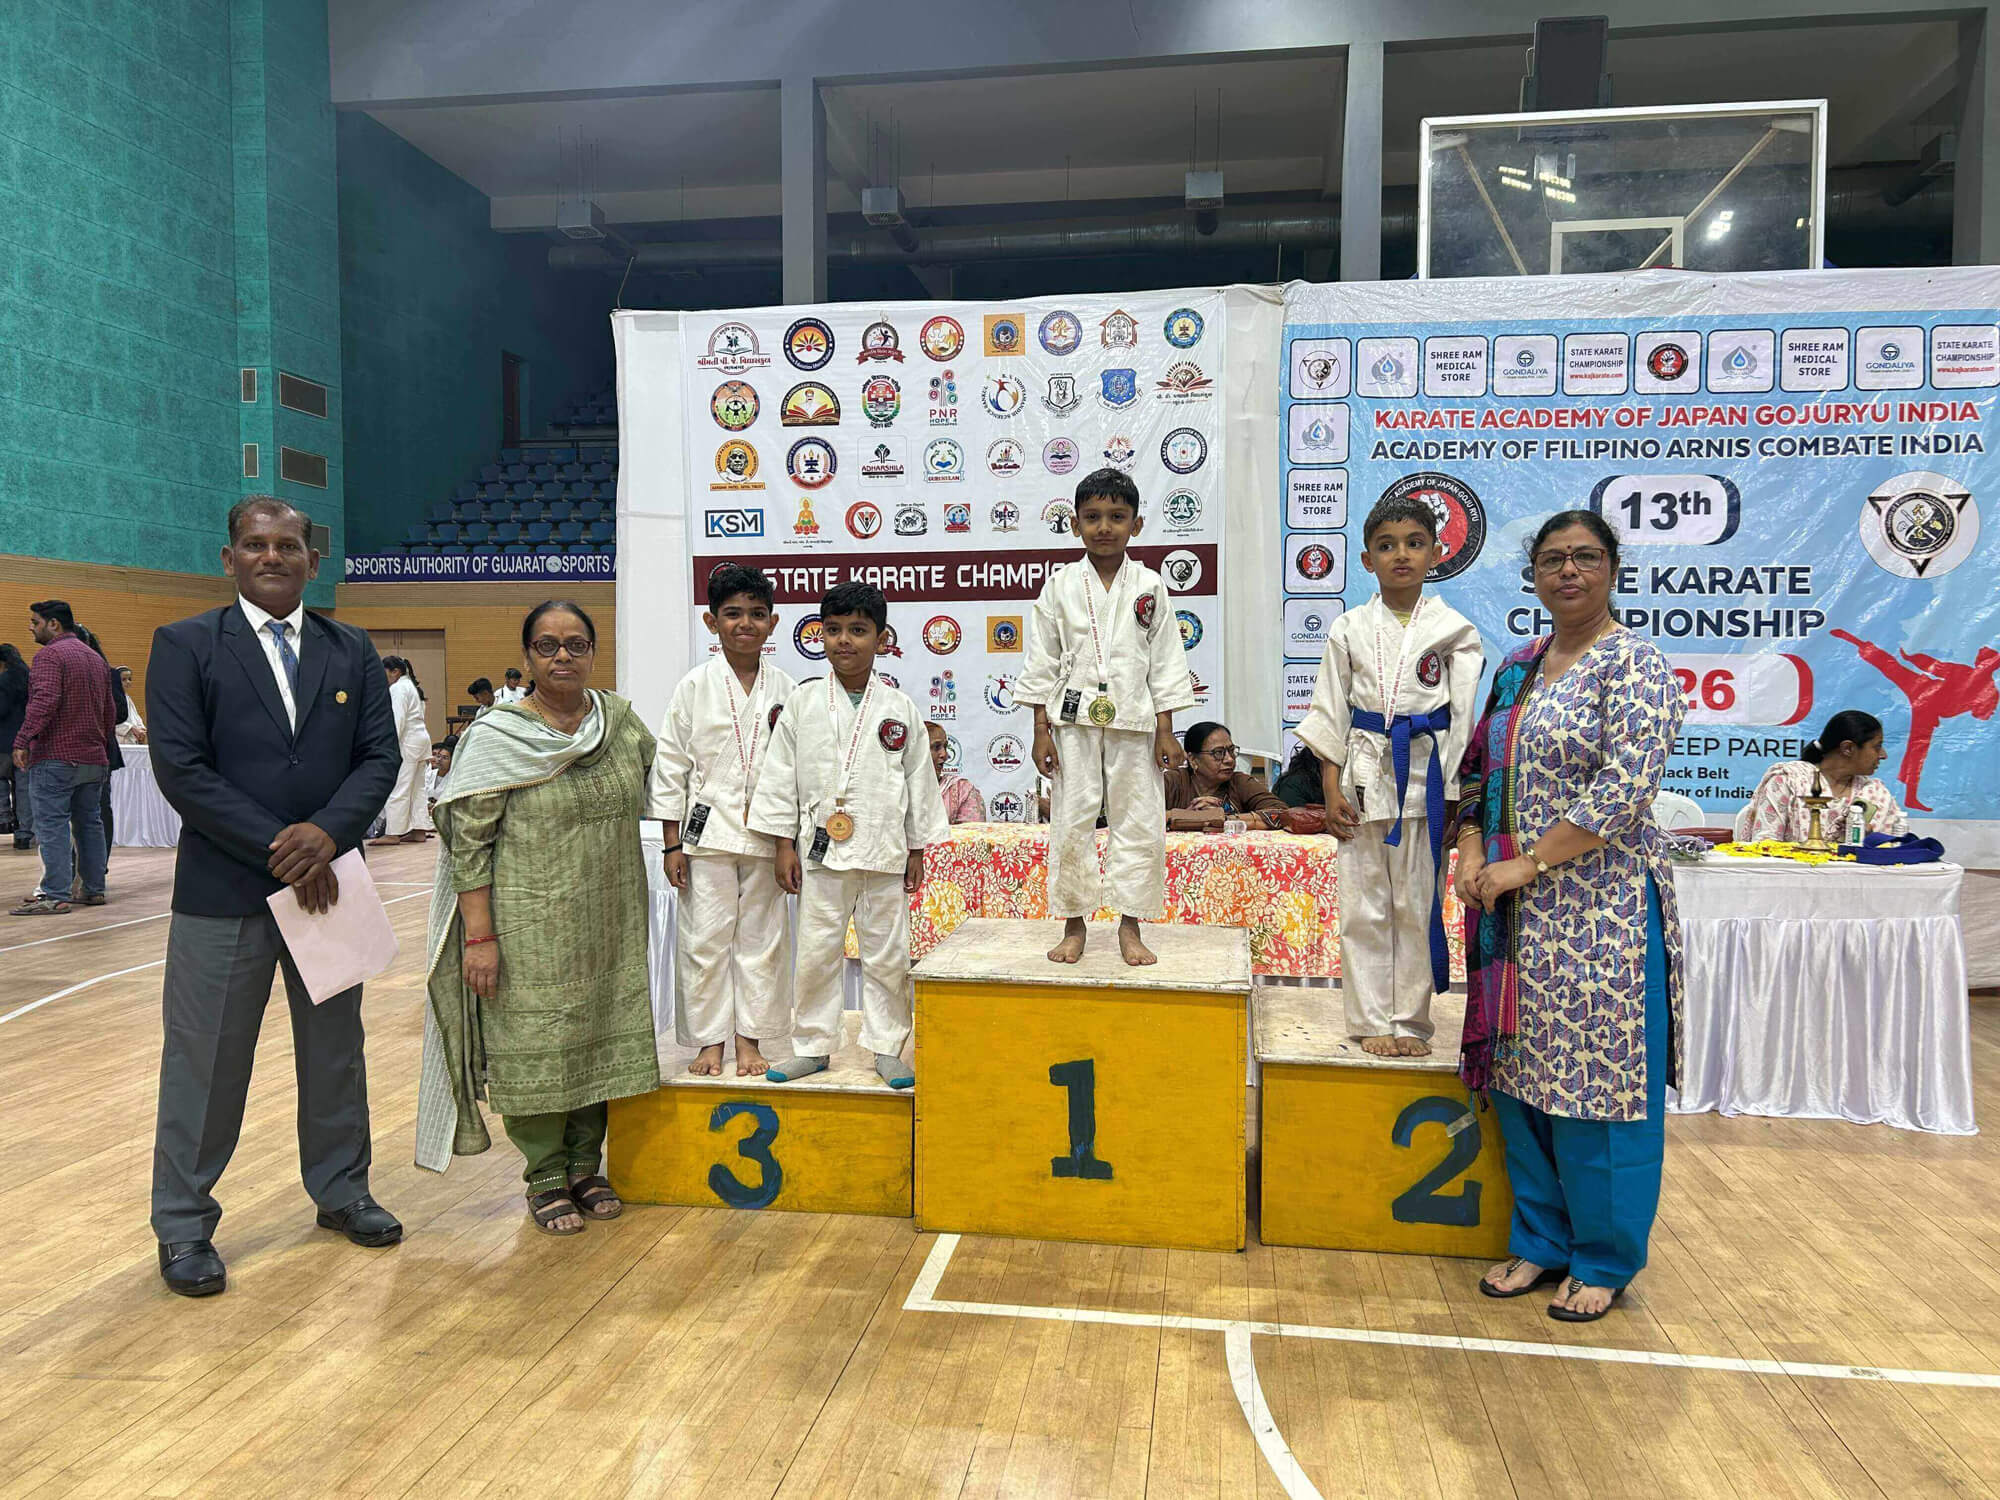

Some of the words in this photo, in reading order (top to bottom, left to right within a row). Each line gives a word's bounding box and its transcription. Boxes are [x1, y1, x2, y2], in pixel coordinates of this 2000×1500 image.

[1788, 342, 1820, 352] SHREE
[1823, 341, 1844, 351] RAM
[1430, 351, 1459, 360] SHREE
[1461, 350, 1482, 359] RAM
[1793, 354, 1838, 364] MEDICAL
[1936, 352, 1995, 361] CHAMPIONSHIP
[1435, 362, 1477, 371] MEDICAL
[1569, 360, 1624, 368] CHAMPIONSHIP
[1798, 366, 1831, 376] STORE
[1441, 373, 1471, 382] STORE
[929, 408, 957, 418] PNR
[1375, 408, 1475, 429] KARATE
[1480, 407, 1610, 428] ACADEMY
[1615, 407, 1652, 427] OF
[1658, 406, 1747, 426] JAPAN
[1755, 403, 1890, 425] GOJURYU
[1899, 402, 1980, 422] INDIA
[1371, 440, 1498, 460] ACADEMY
[1502, 439, 1538, 459] OF
[1544, 438, 1660, 460] FILIPINO
[1666, 437, 1750, 458] ARNIS
[1758, 435, 1893, 457] COMBATE
[1901, 433, 1984, 454] INDIA
[861, 464, 905, 472] ADHARSHILA
[1293, 482, 1322, 493] SHREE
[1324, 482, 1343, 492] RAM
[1298, 494, 1338, 505] MEDICAL
[1394, 478, 1425, 498] ACADEMY
[1437, 479, 1460, 494] JAPAN
[1457, 490, 1475, 507] GOJU
[1468, 507, 1480, 522] RYU
[1302, 506, 1332, 515] STORE
[1620, 491, 1712, 530] 13th
[710, 514, 759, 533] KSM
[355, 557, 401, 575] SPORTS
[404, 556, 470, 574] AUTHORITY
[472, 556, 488, 574] OF
[491, 555, 547, 573] GUJARAT
[562, 555, 610, 573] SPORTS
[762, 567, 839, 593] STATE
[849, 565, 946, 592] KARATE
[957, 560, 1066, 590] CHAMPI
[1651, 567, 1811, 594] KARATE
[1507, 608, 1825, 637] CHPIONSHIP
[1288, 676, 1308, 684] STATE
[1672, 668, 1736, 711] 26
[930, 705, 957, 713] PNR
[1671, 737, 1720, 755] EEP
[1662, 767, 1693, 779] lack
[1698, 767, 1729, 779] Belt
[1695, 786, 1712, 798] of
[1715, 787, 1754, 799] India
[1049, 1059, 1113, 1180] 1
[708, 1102, 783, 1210] 3
[1391, 1096, 1482, 1227] 2
